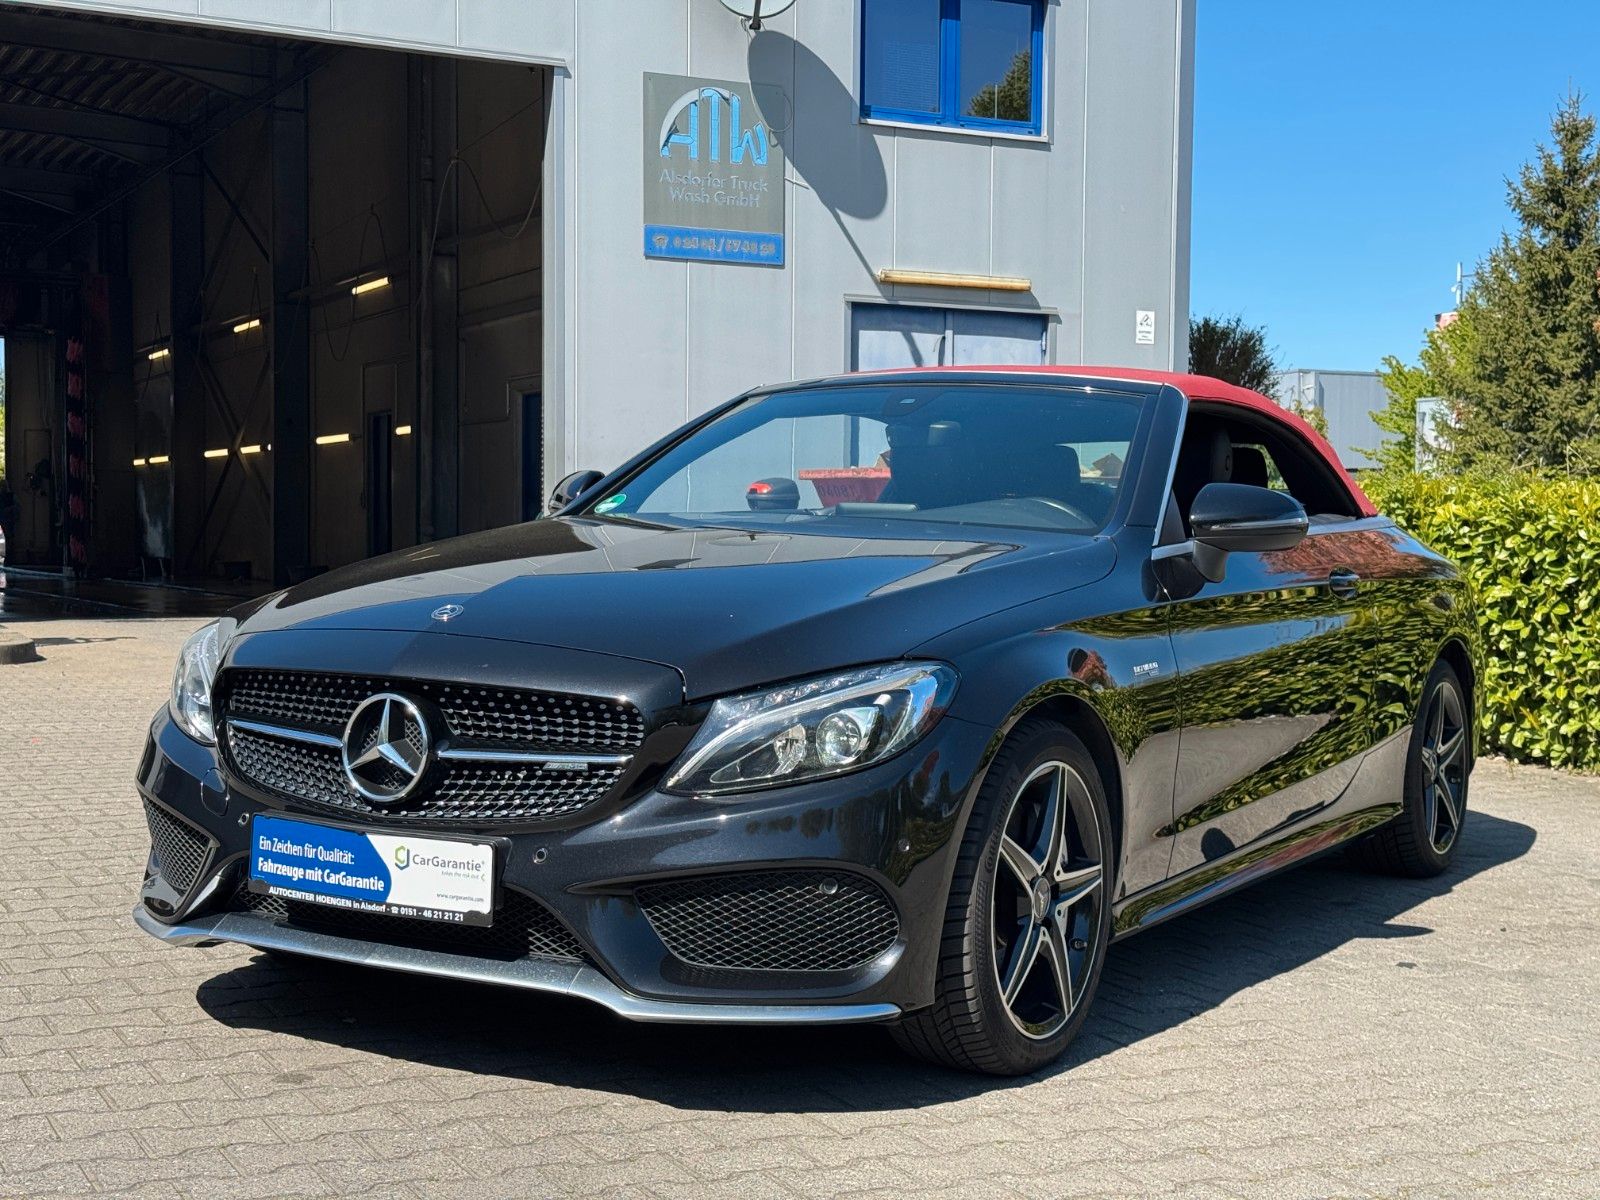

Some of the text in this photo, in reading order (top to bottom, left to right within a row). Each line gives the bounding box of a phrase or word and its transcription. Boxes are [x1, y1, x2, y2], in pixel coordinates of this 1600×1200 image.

[659, 168, 769, 192] Alsdorfer Truck
[670, 186, 760, 207] Wash GmbH
[259, 835, 355, 865] Ein Zeichen für Qualität:
[258, 857, 385, 892] Fahrzeuge mit CarGarantie
[268, 886, 315, 902] AUTOCENTER
[316, 894, 352, 908] HOENGEN
[353, 900, 360, 909] in
[360, 902, 386, 913] Alsdorf
[400, 906, 417, 916] 0151
[423, 909, 433, 918] 46
[433, 910, 442, 919] 21
[443, 912, 453, 920] 21
[454, 913, 464, 921] 21
